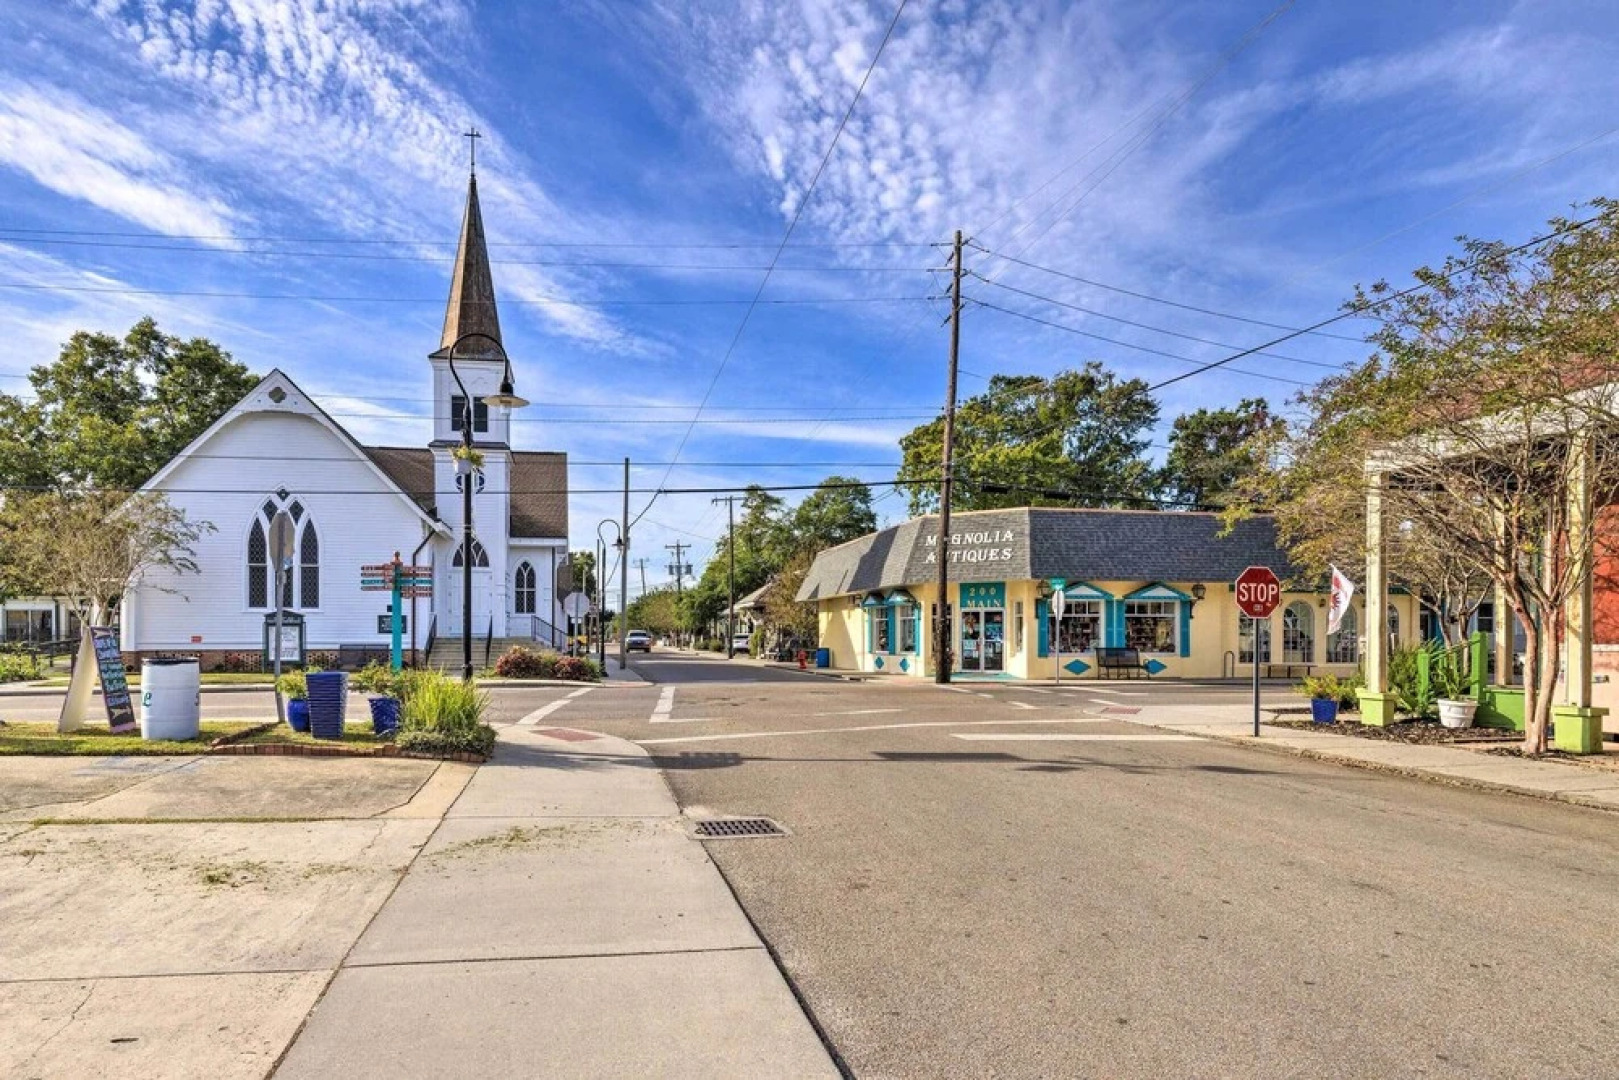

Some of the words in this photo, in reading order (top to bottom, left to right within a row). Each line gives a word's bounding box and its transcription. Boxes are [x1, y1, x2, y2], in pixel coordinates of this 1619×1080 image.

[925, 530, 1015, 547] MGNOLIA
[969, 587, 996, 597] 200
[1239, 582, 1278, 602] STOP
[967, 598, 1001, 609] MAIN
